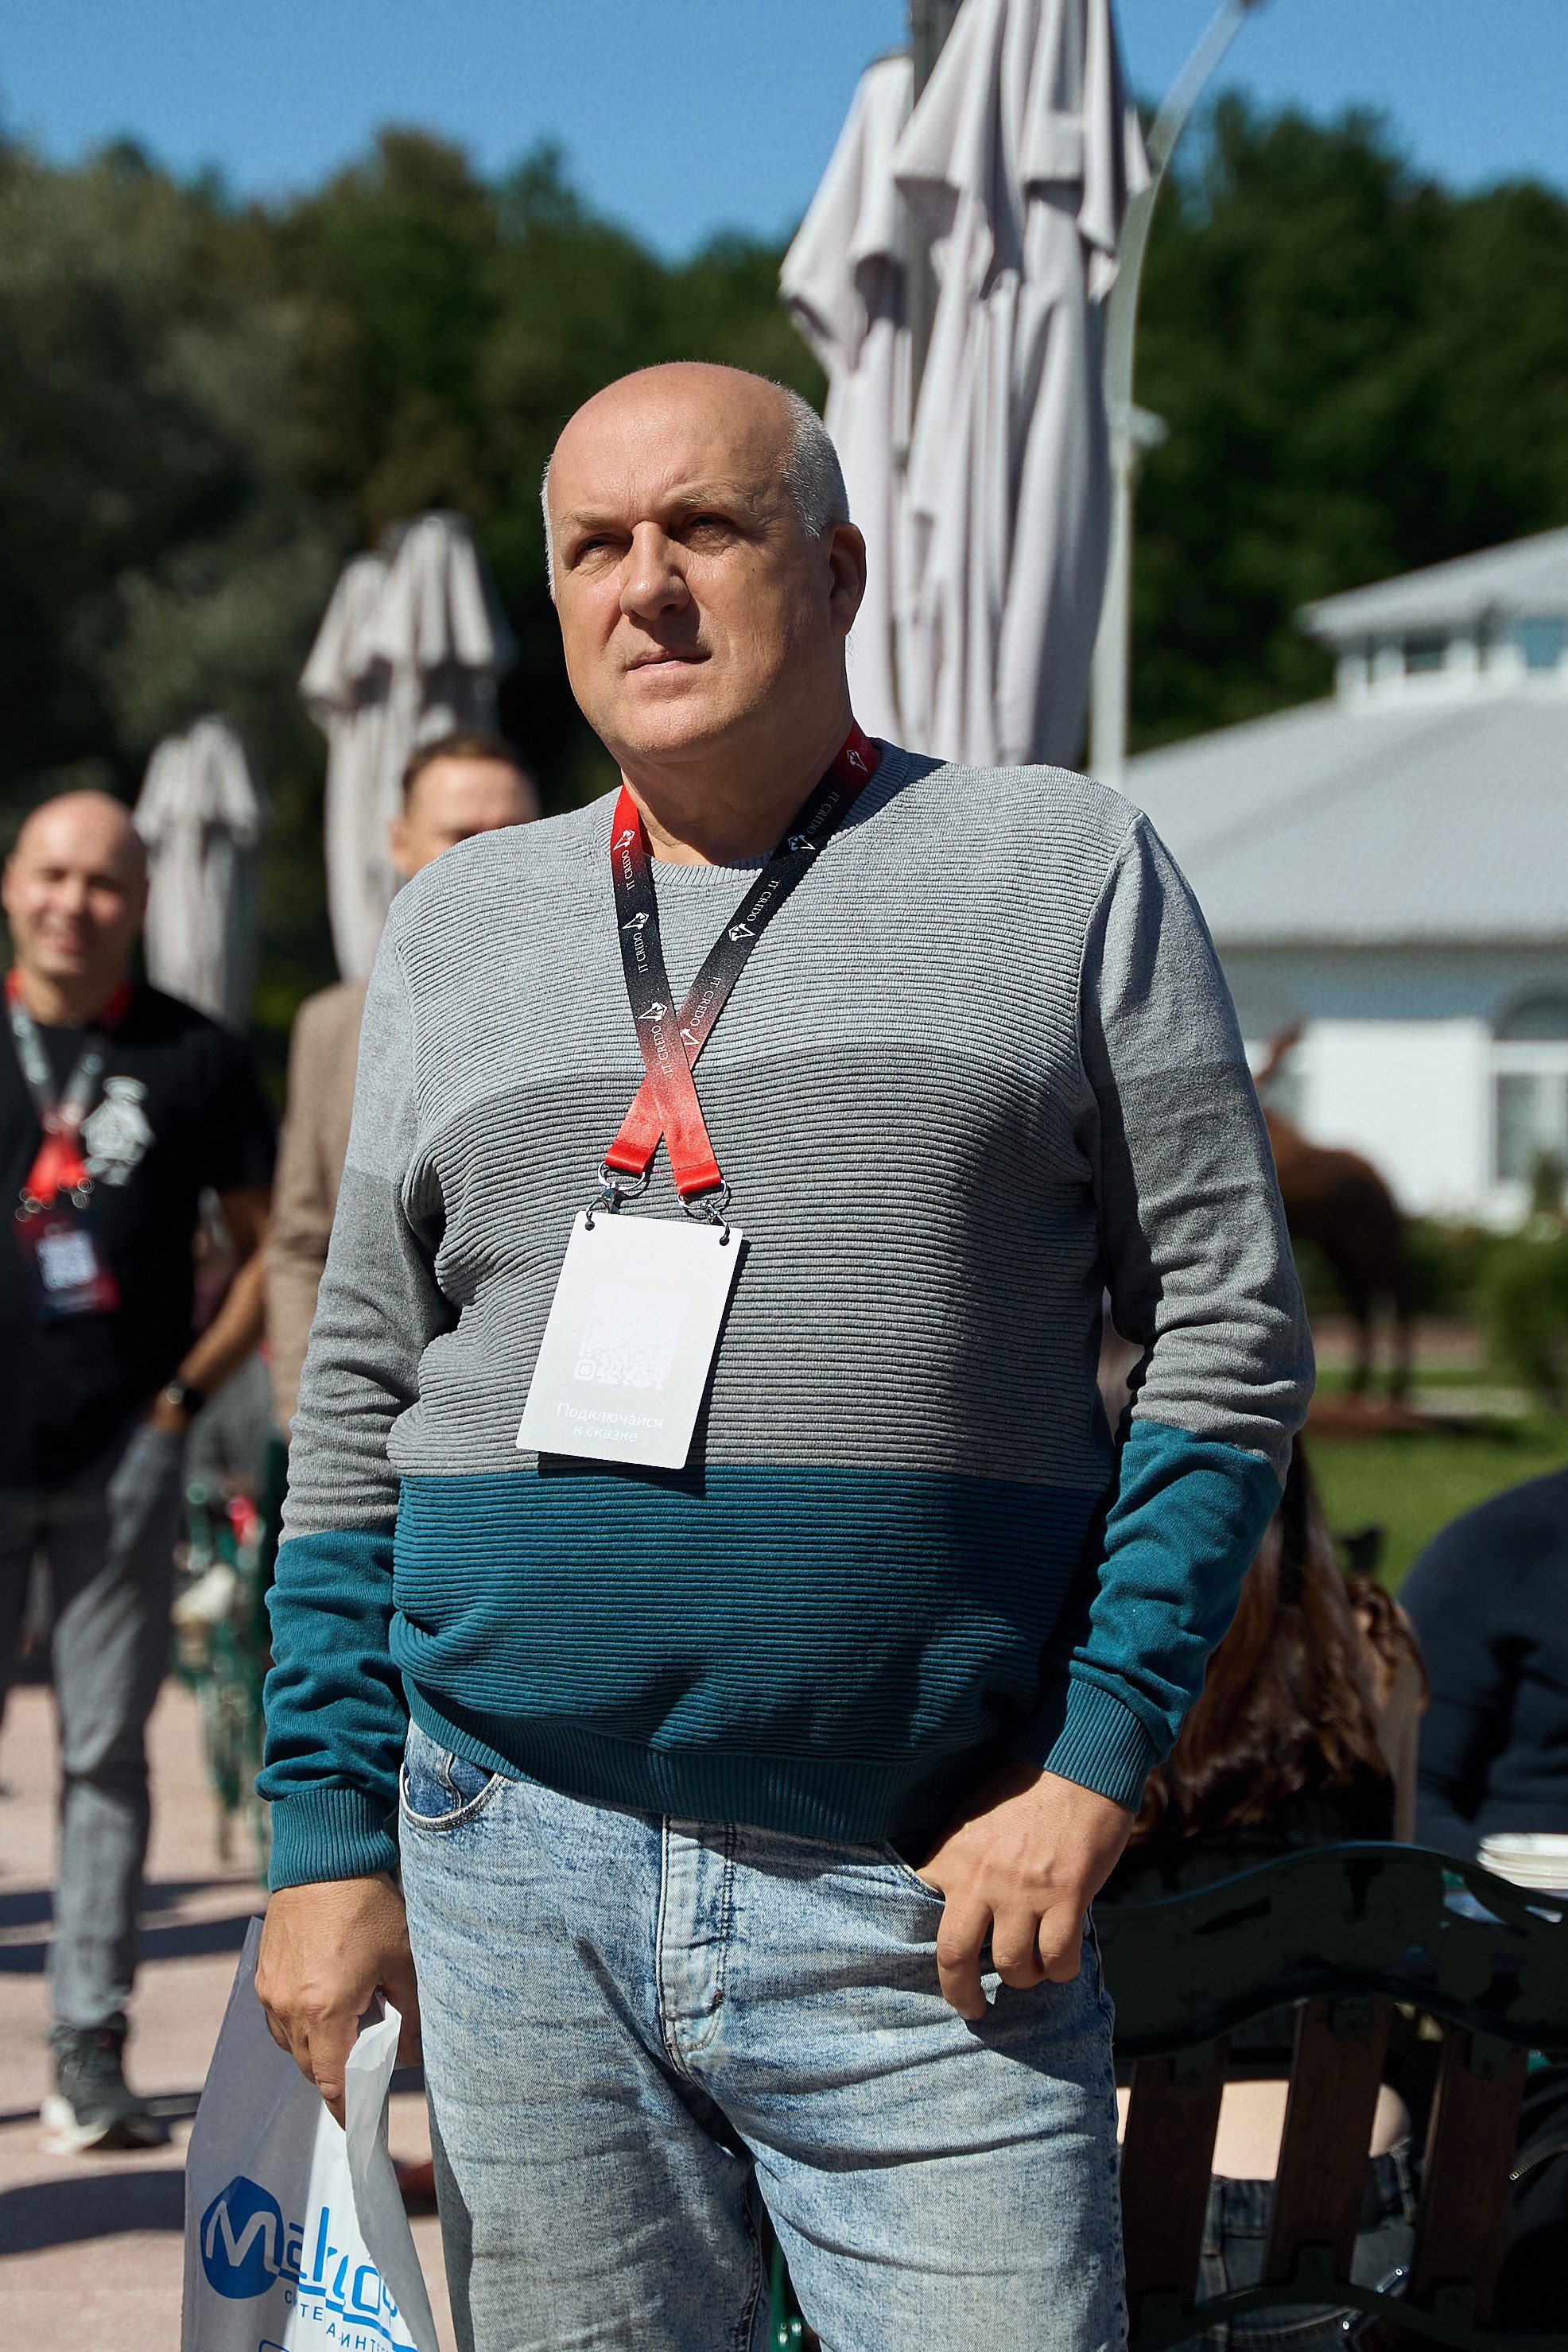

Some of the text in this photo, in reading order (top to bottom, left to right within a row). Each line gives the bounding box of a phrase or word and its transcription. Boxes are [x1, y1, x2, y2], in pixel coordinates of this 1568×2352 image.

[806, 791, 840, 834] IT CREDO
[621, 849, 635, 891] IT CREDO
[747, 879, 779, 922] IT CREDO
[633, 932, 649, 973] IT CREDO
[690, 976, 722, 1027] IT CREDO
[650, 1024, 673, 1075] IT CREDO
[556, 1403, 663, 1429] Подключайся
[586, 1426, 638, 1443] сказке
